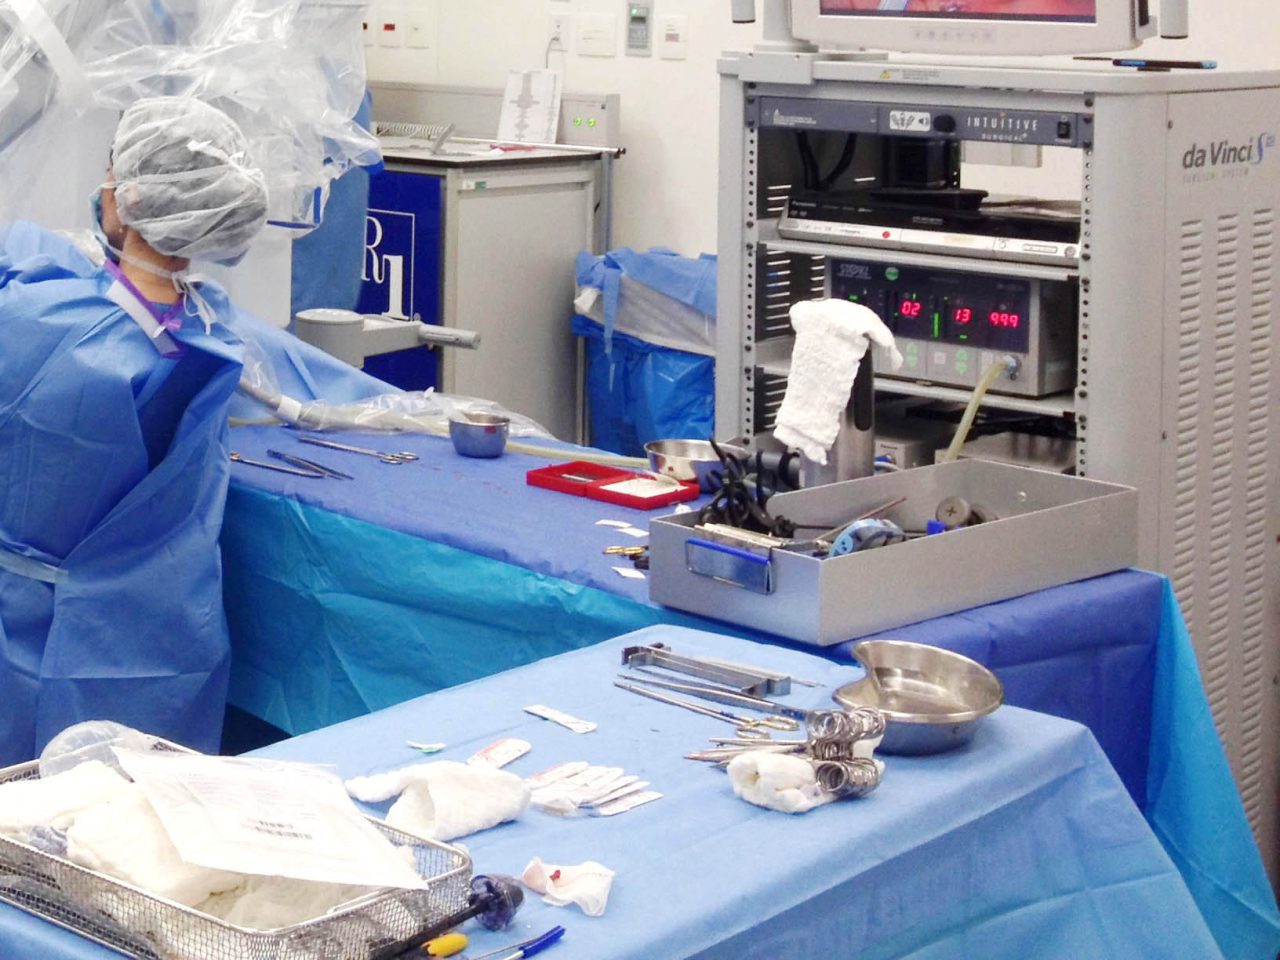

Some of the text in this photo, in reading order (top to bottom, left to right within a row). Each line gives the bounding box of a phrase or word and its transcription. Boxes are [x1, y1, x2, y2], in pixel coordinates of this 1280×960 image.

[967, 116, 1039, 131] INTUITIVE
[1182, 143, 1207, 169] da
[1210, 137, 1253, 166] Vinci
[901, 301, 921, 316] 02
[955, 308, 972, 323] 13
[990, 312, 1019, 328] 999
